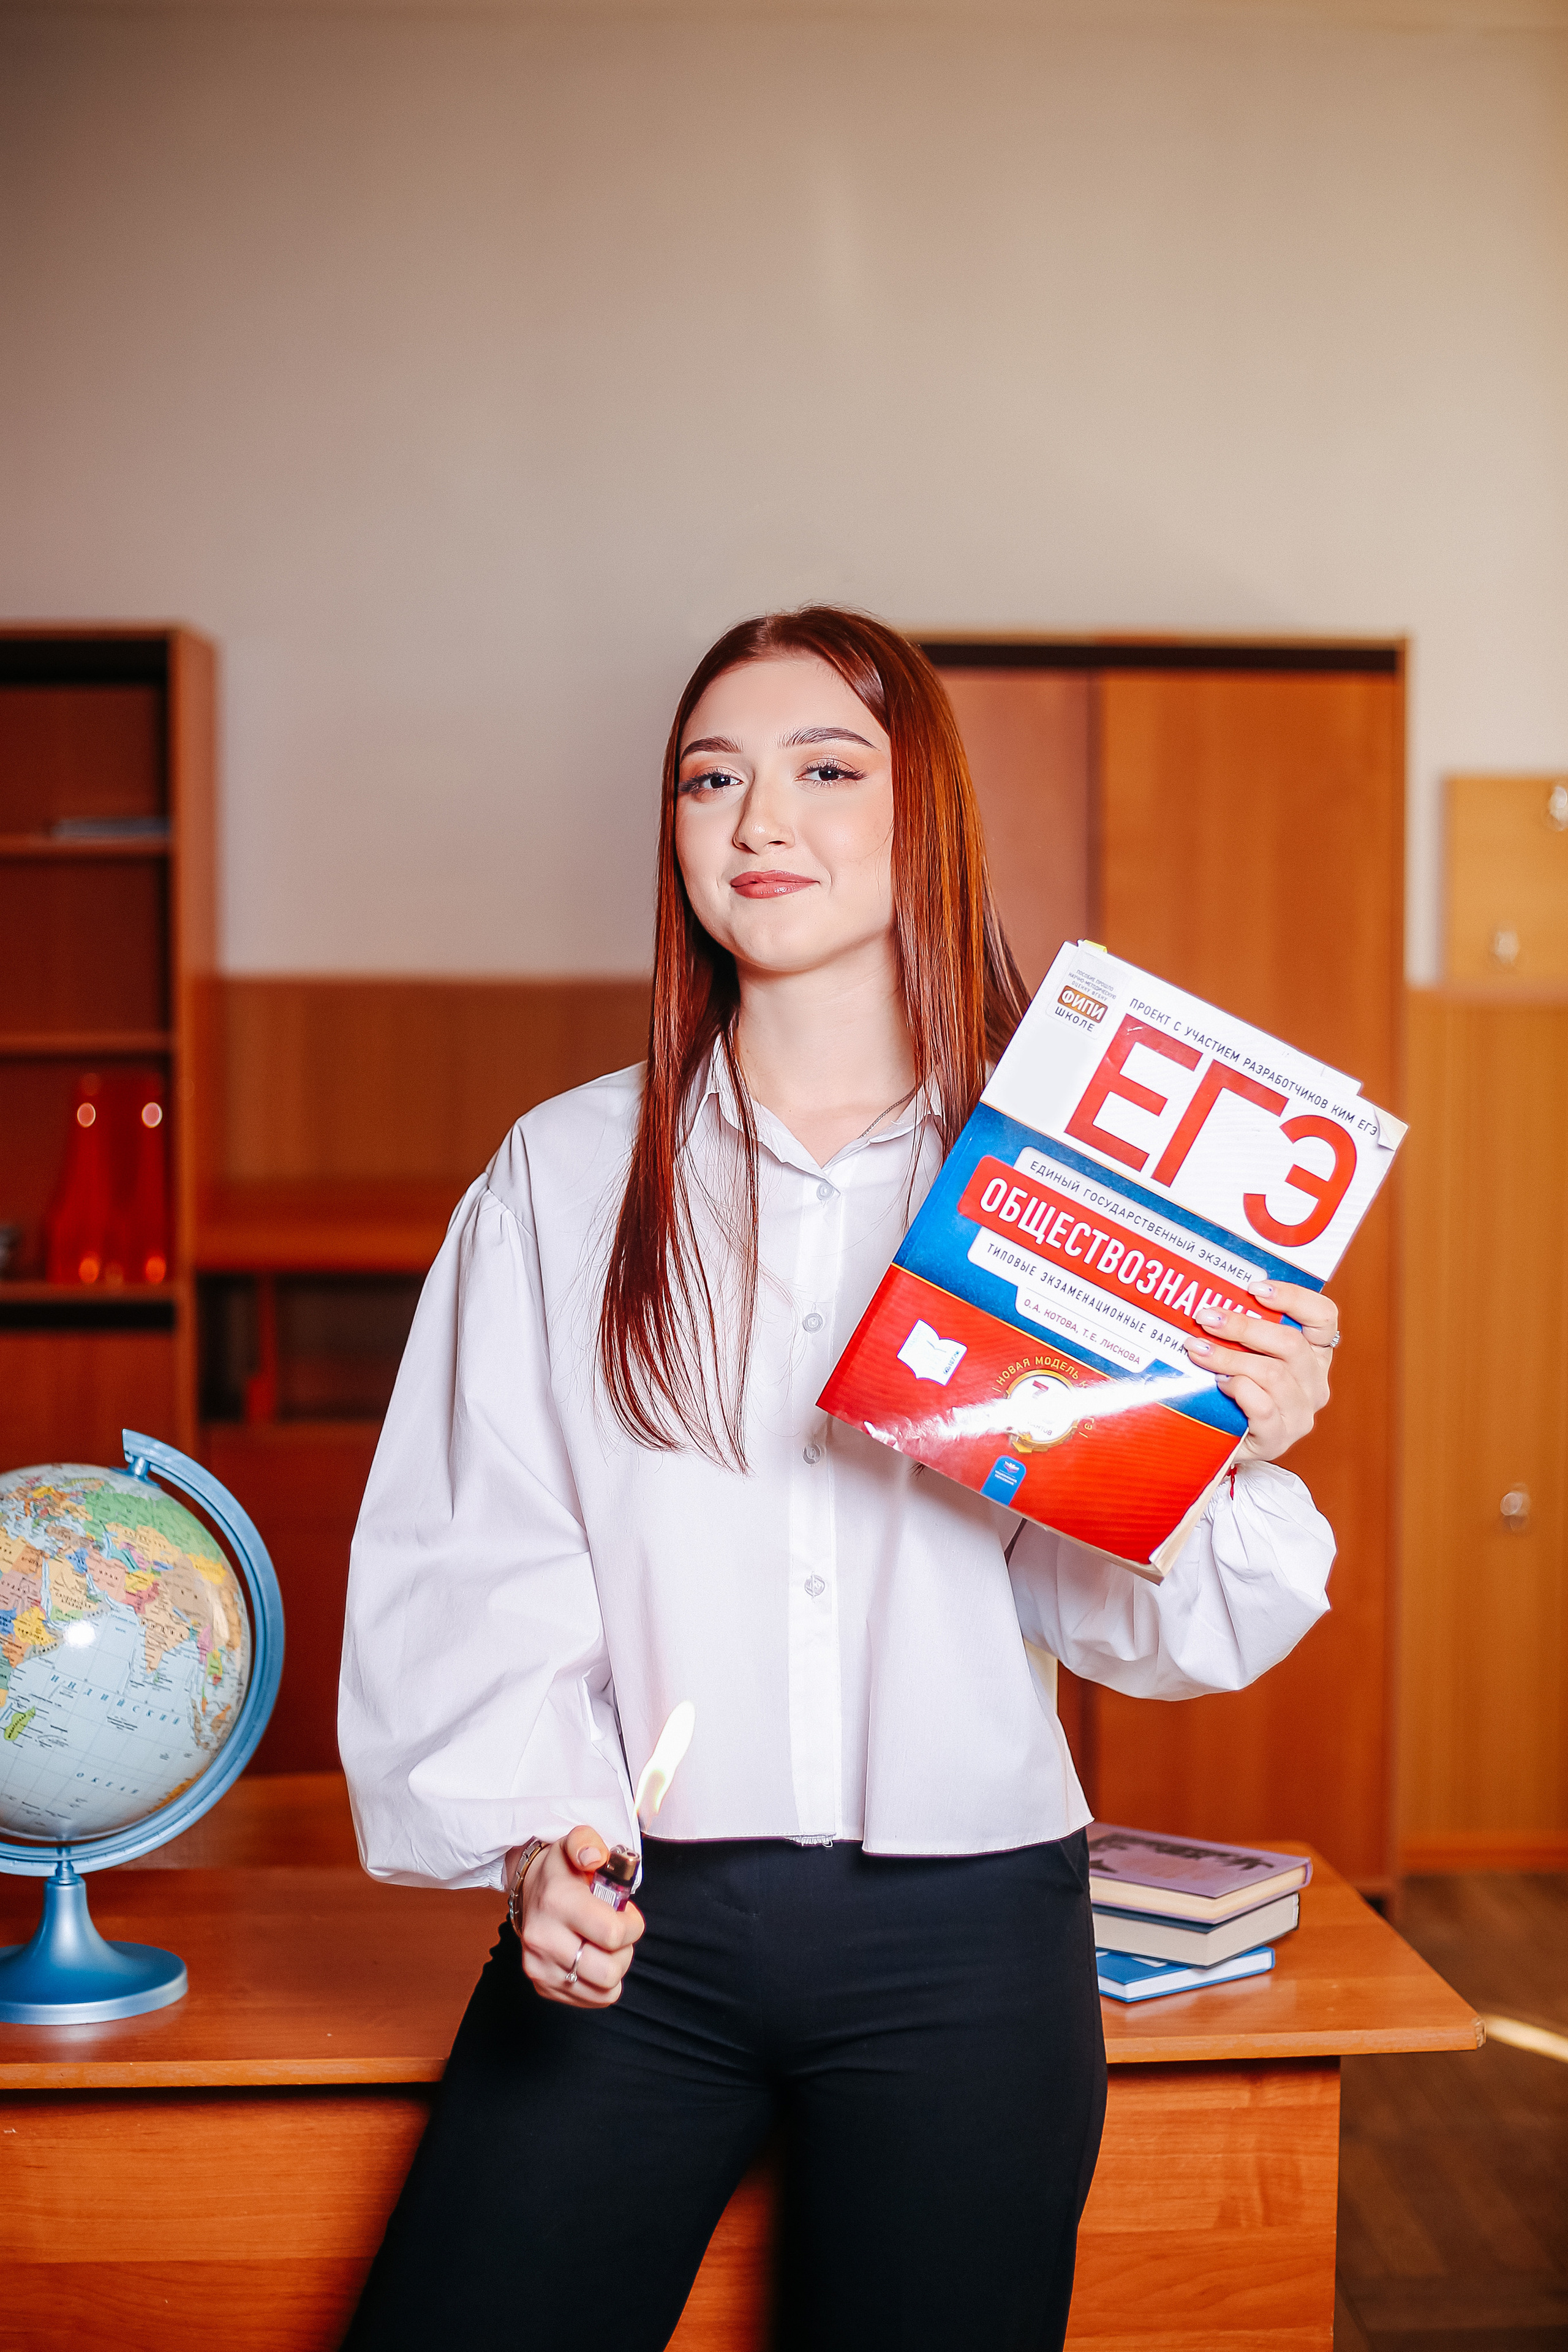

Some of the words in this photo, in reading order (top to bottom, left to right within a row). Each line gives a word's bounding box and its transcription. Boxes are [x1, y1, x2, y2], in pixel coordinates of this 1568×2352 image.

[1072, 981, 1090, 992] ОЦЕНКУ
[1076, 970, 1095, 982] ПОСОБИЕ
[1055, 1006, 1095, 1032] ШКОЛЕ
[1061, 990, 1105, 1020] ФИПИ
[1129, 998, 1172, 1025] ПРОЕКТ
[1174, 1022, 1182, 1031] С
[1184, 1027, 1240, 1062] УЧАСТИЕМ
[1243, 1058, 1329, 1109] РАЗРАБОТЧИКОВ
[1330, 1104, 1355, 1123] КИМ
[1357, 1119, 1378, 1136] ЕГЭ
[1065, 1013, 1358, 1247] ЕГЭ
[1030, 1161, 1080, 1193] ЕДИНЫЙ
[1083, 1188, 1196, 1253] ГОСУДАРСТВЕННЫЙ
[1198, 1250, 1253, 1283] ЭКЗАМЕН
[987, 1243, 1037, 1276] ТИПОВЫЕ
[1041, 1272, 1147, 1333] ЭКЗАМЕНАЦИОННЫЕ
[1044, 1308, 1079, 1333] КОТОВА,
[1099, 1338, 1140, 1365] ЛИСКОВА
[996, 1358, 1030, 1385] НОВАЯ
[1035, 1356, 1079, 1379] МОДЕЛЬ
